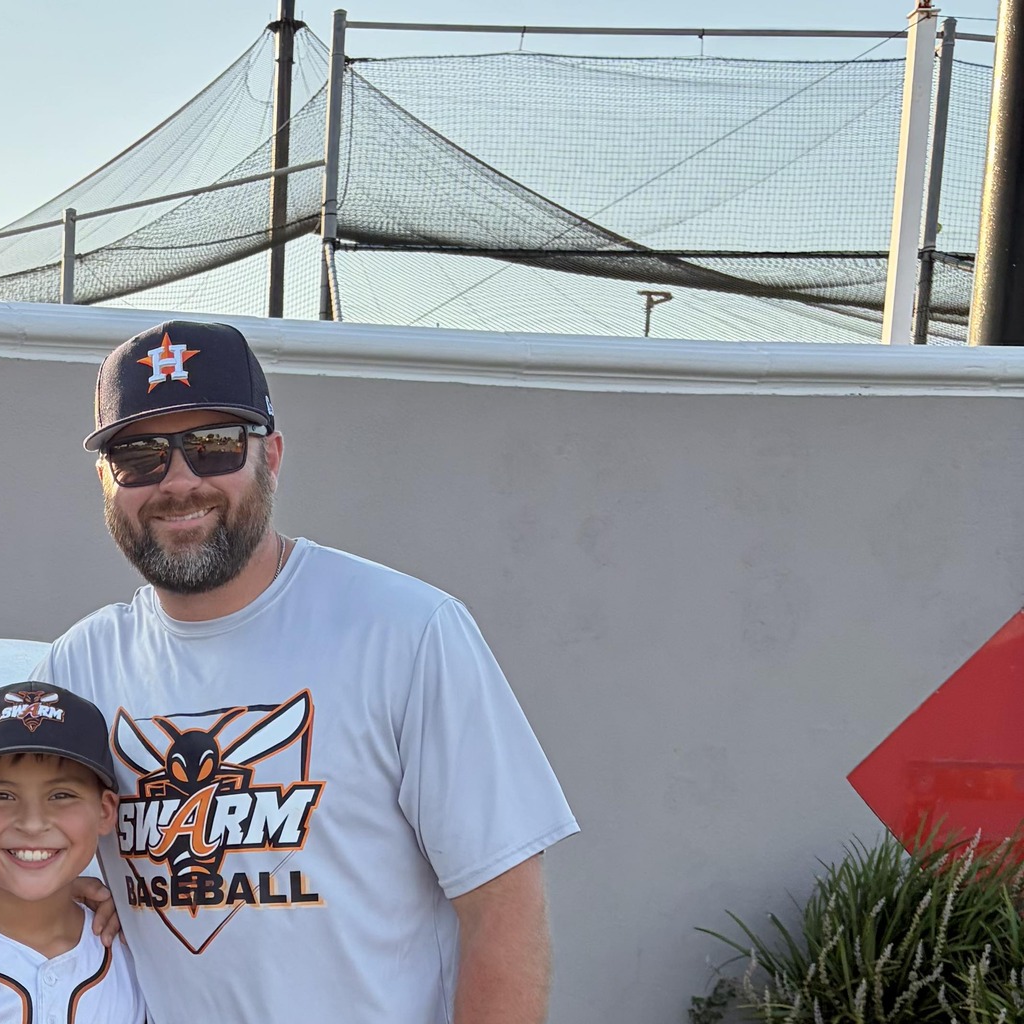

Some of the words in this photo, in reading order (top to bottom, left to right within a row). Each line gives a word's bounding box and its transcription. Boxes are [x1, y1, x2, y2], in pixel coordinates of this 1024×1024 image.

[147, 344, 189, 385] H
[0, 702, 64, 720] SWARM
[118, 783, 318, 858] SWARM
[125, 870, 322, 908] BASEBALL
